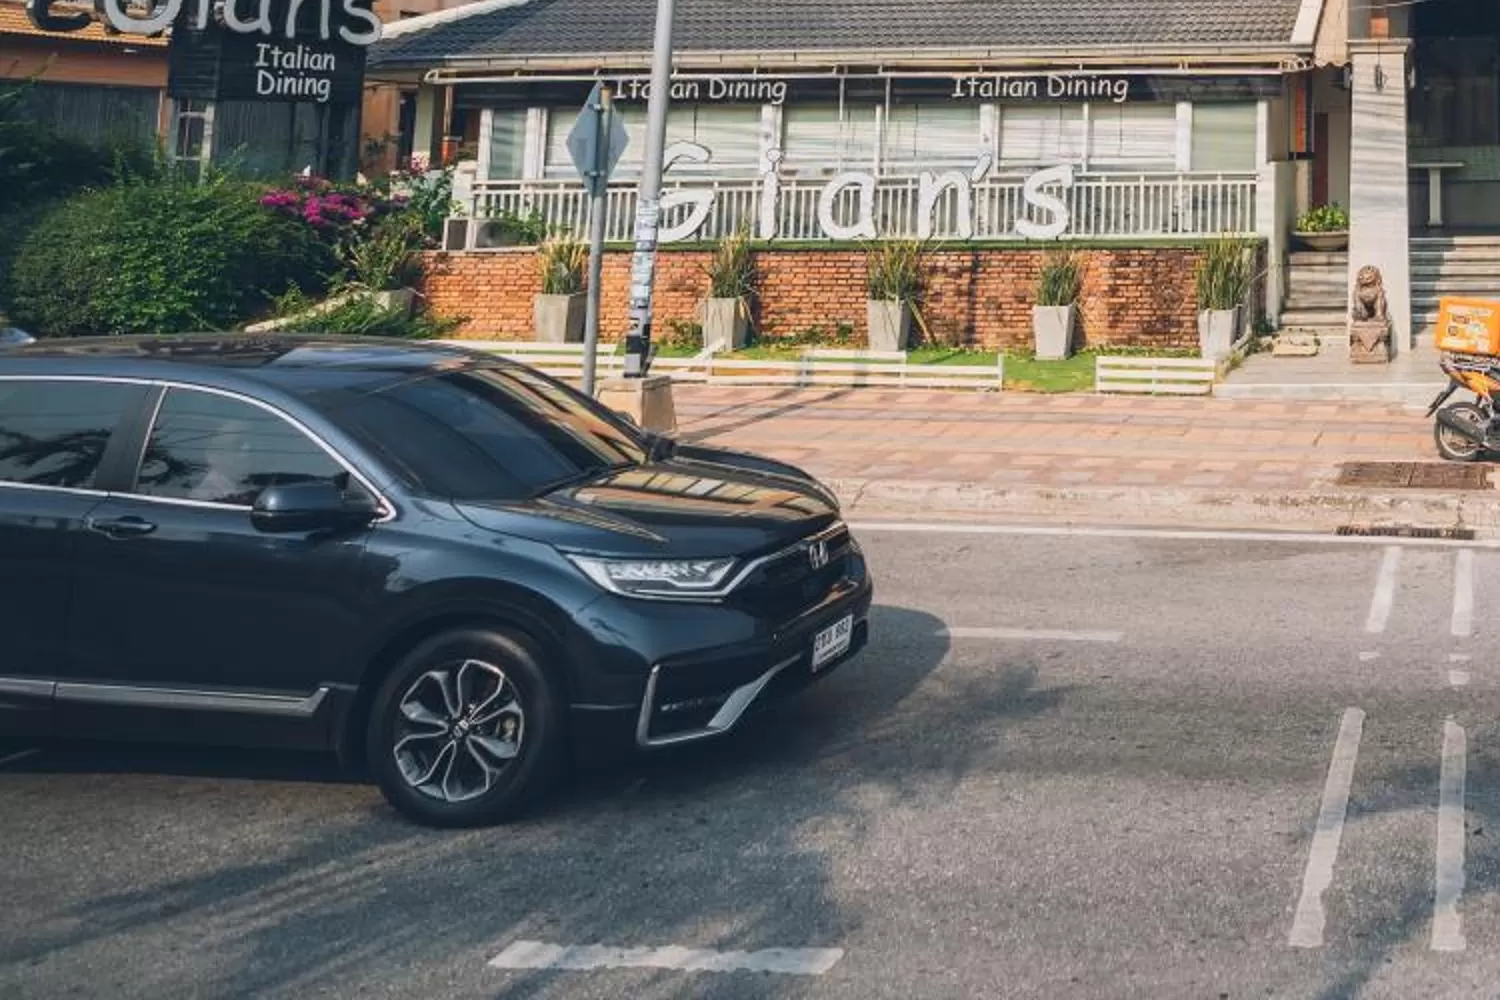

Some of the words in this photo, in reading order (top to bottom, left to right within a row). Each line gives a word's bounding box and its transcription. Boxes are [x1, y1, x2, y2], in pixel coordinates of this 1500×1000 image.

[254, 42, 336, 71] Italian
[255, 70, 332, 102] Dining
[613, 78, 700, 101] Itaan
[708, 77, 787, 105] Dining
[951, 75, 1038, 98] Italian
[1047, 74, 1130, 103] Dining
[655, 139, 1075, 244] Gian's
